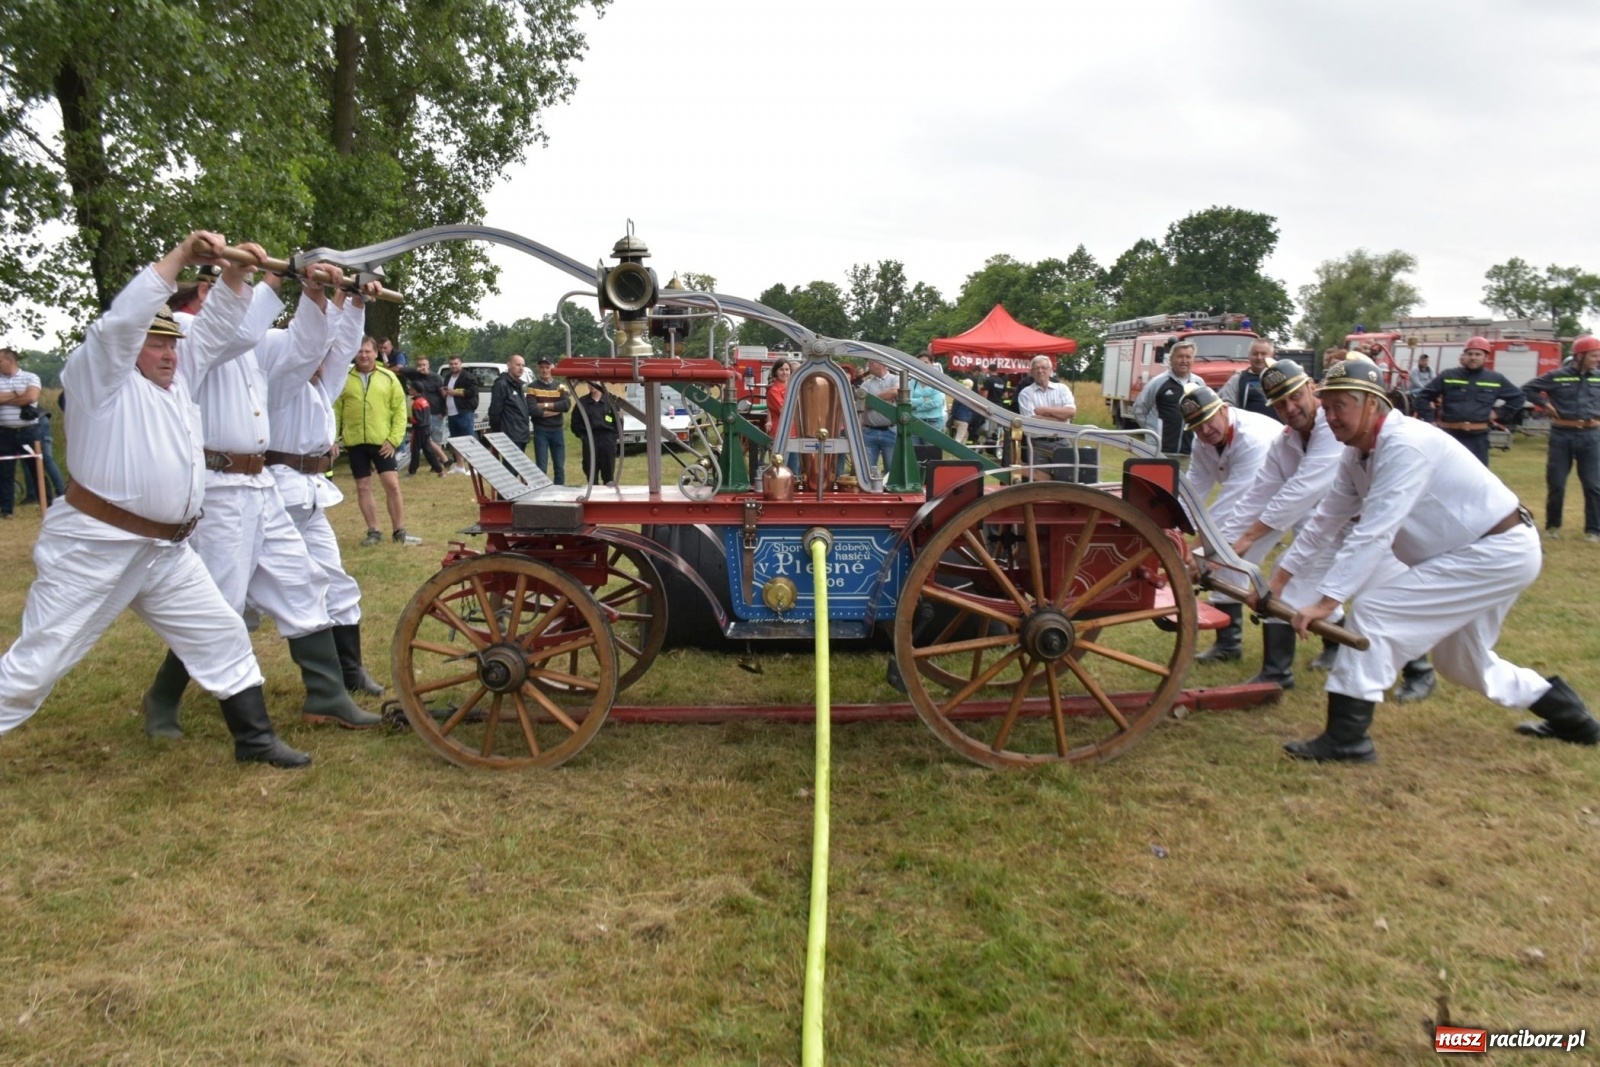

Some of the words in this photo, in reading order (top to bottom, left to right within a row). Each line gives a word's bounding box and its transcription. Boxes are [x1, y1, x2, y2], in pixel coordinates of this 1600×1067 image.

[952, 355, 973, 367] OSP
[772, 543, 802, 552] Sbor
[758, 563, 769, 573] v
